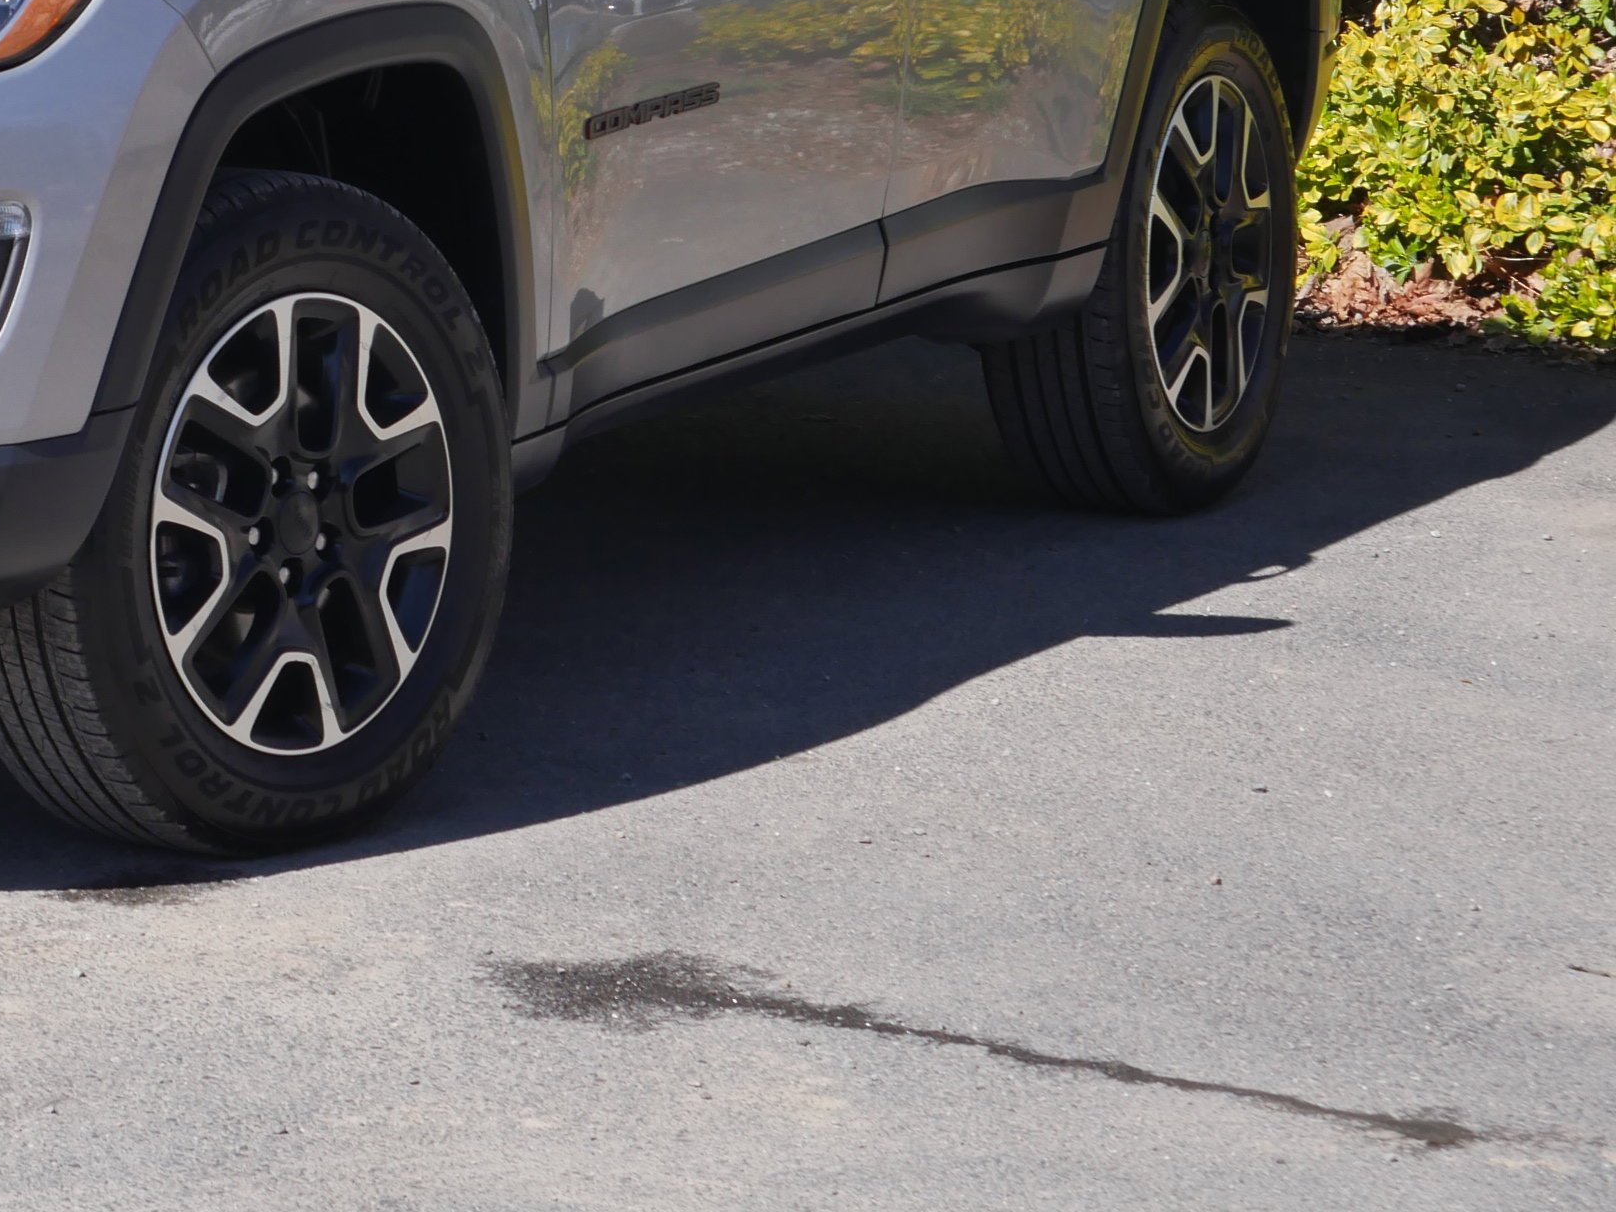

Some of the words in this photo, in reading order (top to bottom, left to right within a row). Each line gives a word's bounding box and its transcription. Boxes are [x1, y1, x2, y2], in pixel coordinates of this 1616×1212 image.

[584, 82, 721, 141] COMPASS
[178, 228, 280, 340] ROAD
[295, 219, 466, 332] CONTROL
